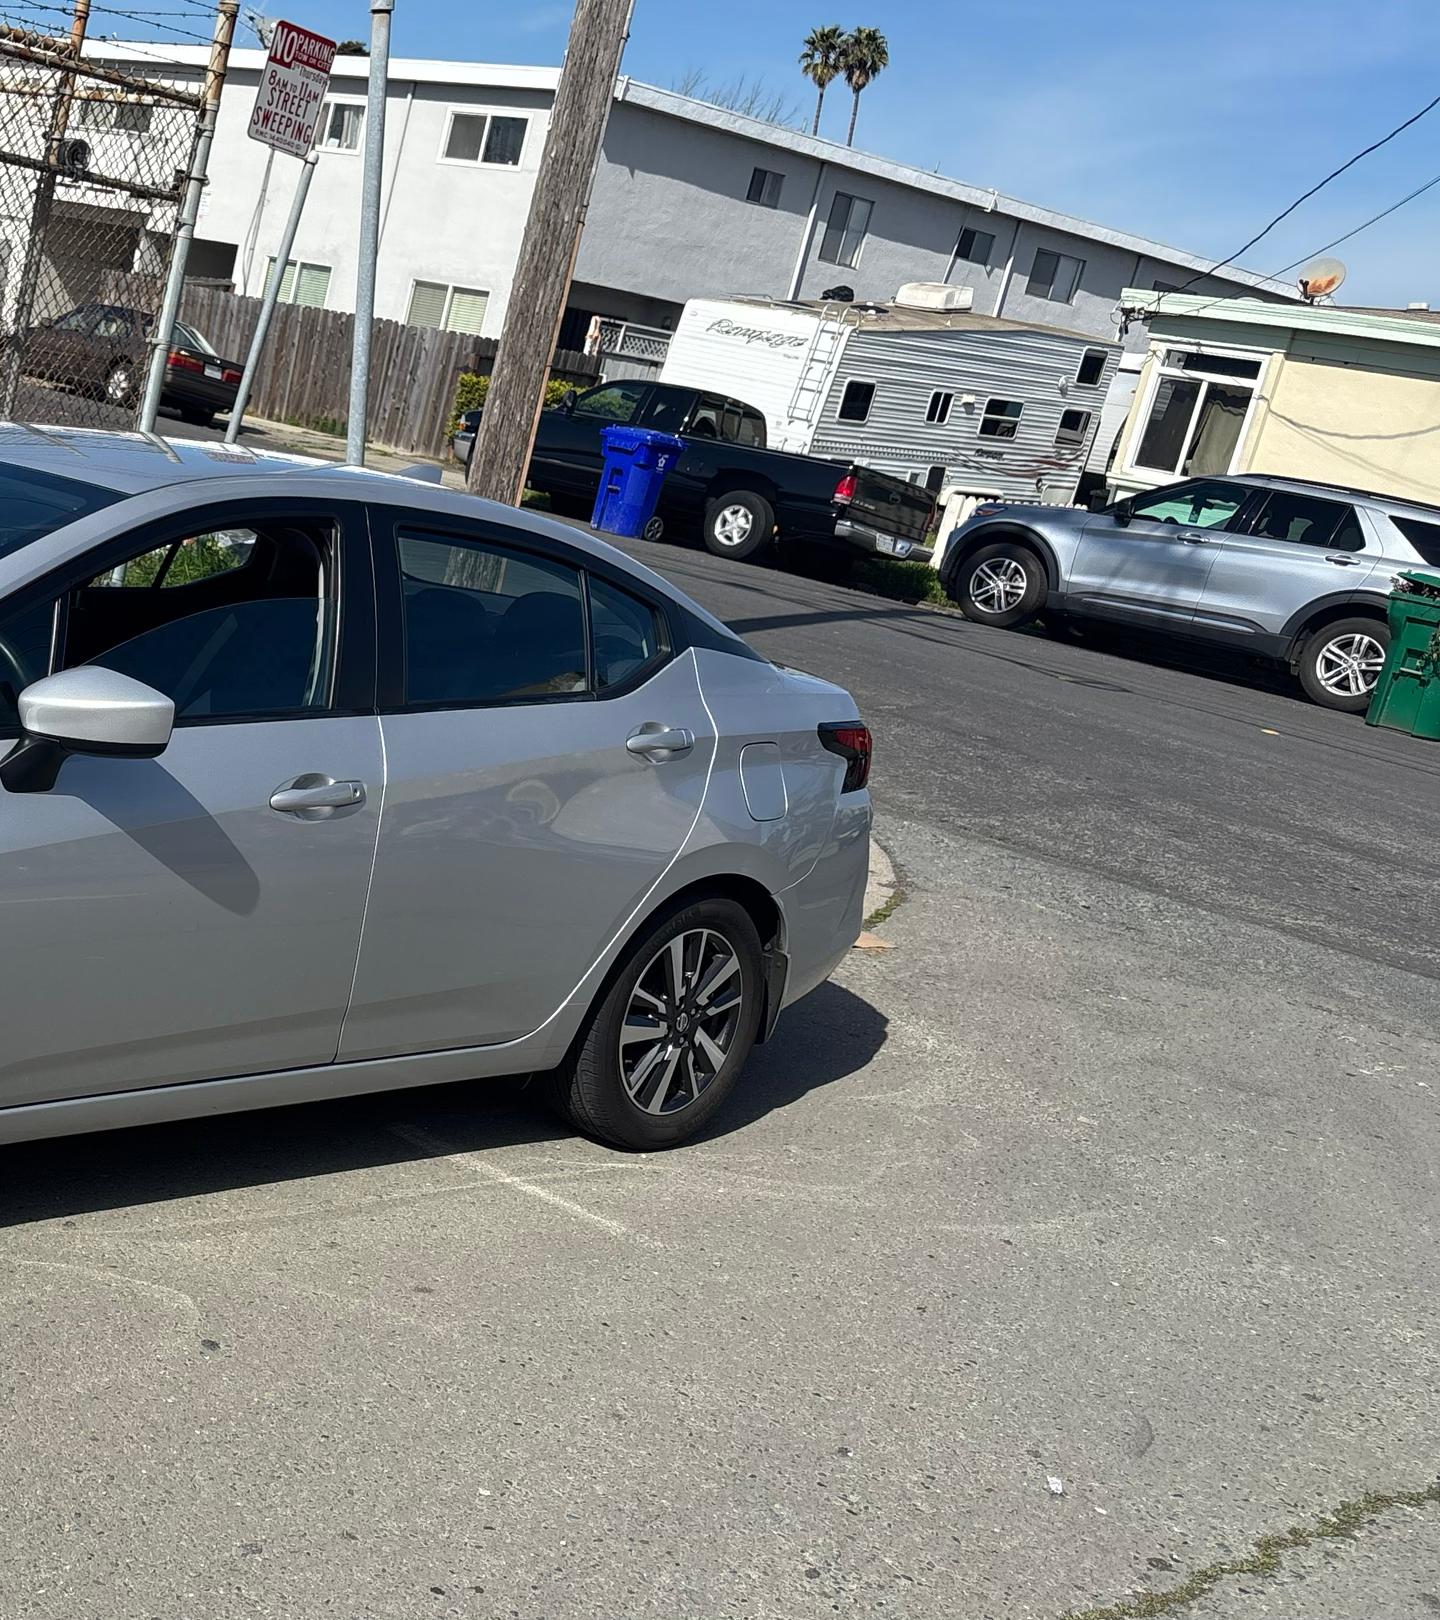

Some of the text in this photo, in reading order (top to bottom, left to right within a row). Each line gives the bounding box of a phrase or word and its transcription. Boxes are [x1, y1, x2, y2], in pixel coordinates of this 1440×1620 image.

[271, 26, 336, 64] NO PARKING
[295, 51, 330, 71] TOW OR CITE
[267, 87, 311, 119] STREET
[268, 69, 319, 103] 8AM TO 11AM
[253, 106, 312, 144] SWEEPING
